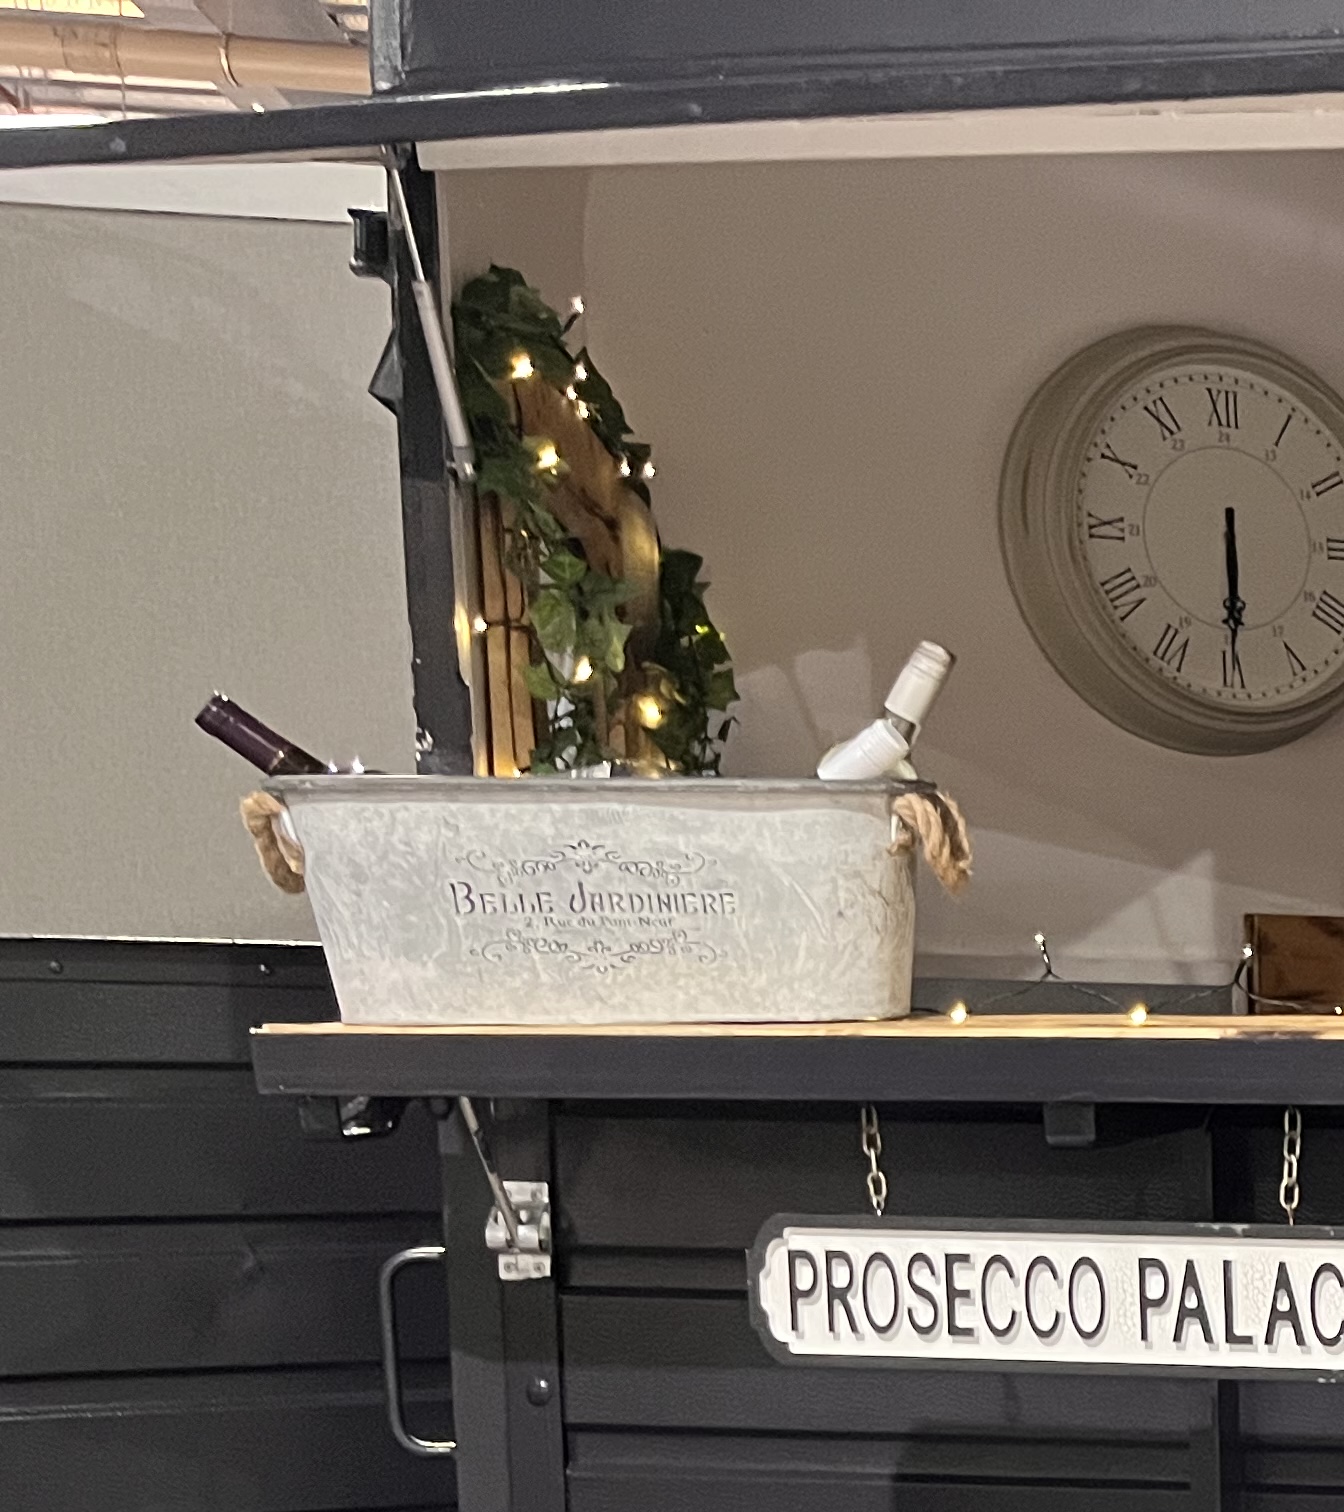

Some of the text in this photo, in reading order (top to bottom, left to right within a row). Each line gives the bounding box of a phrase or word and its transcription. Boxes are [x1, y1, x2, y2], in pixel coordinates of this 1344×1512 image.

[1143, 396, 1181, 441] XI
[1206, 387, 1239, 429] XII
[1100, 441, 1138, 479] X
[1087, 511, 1125, 542] IX
[1100, 567, 1147, 621] VIII
[1152, 623, 1189, 673] VII
[1282, 641, 1307, 676] V
[449, 881, 737, 915] BELLE JARDINIERE
[787, 1249, 1108, 1342] PROSECCO
